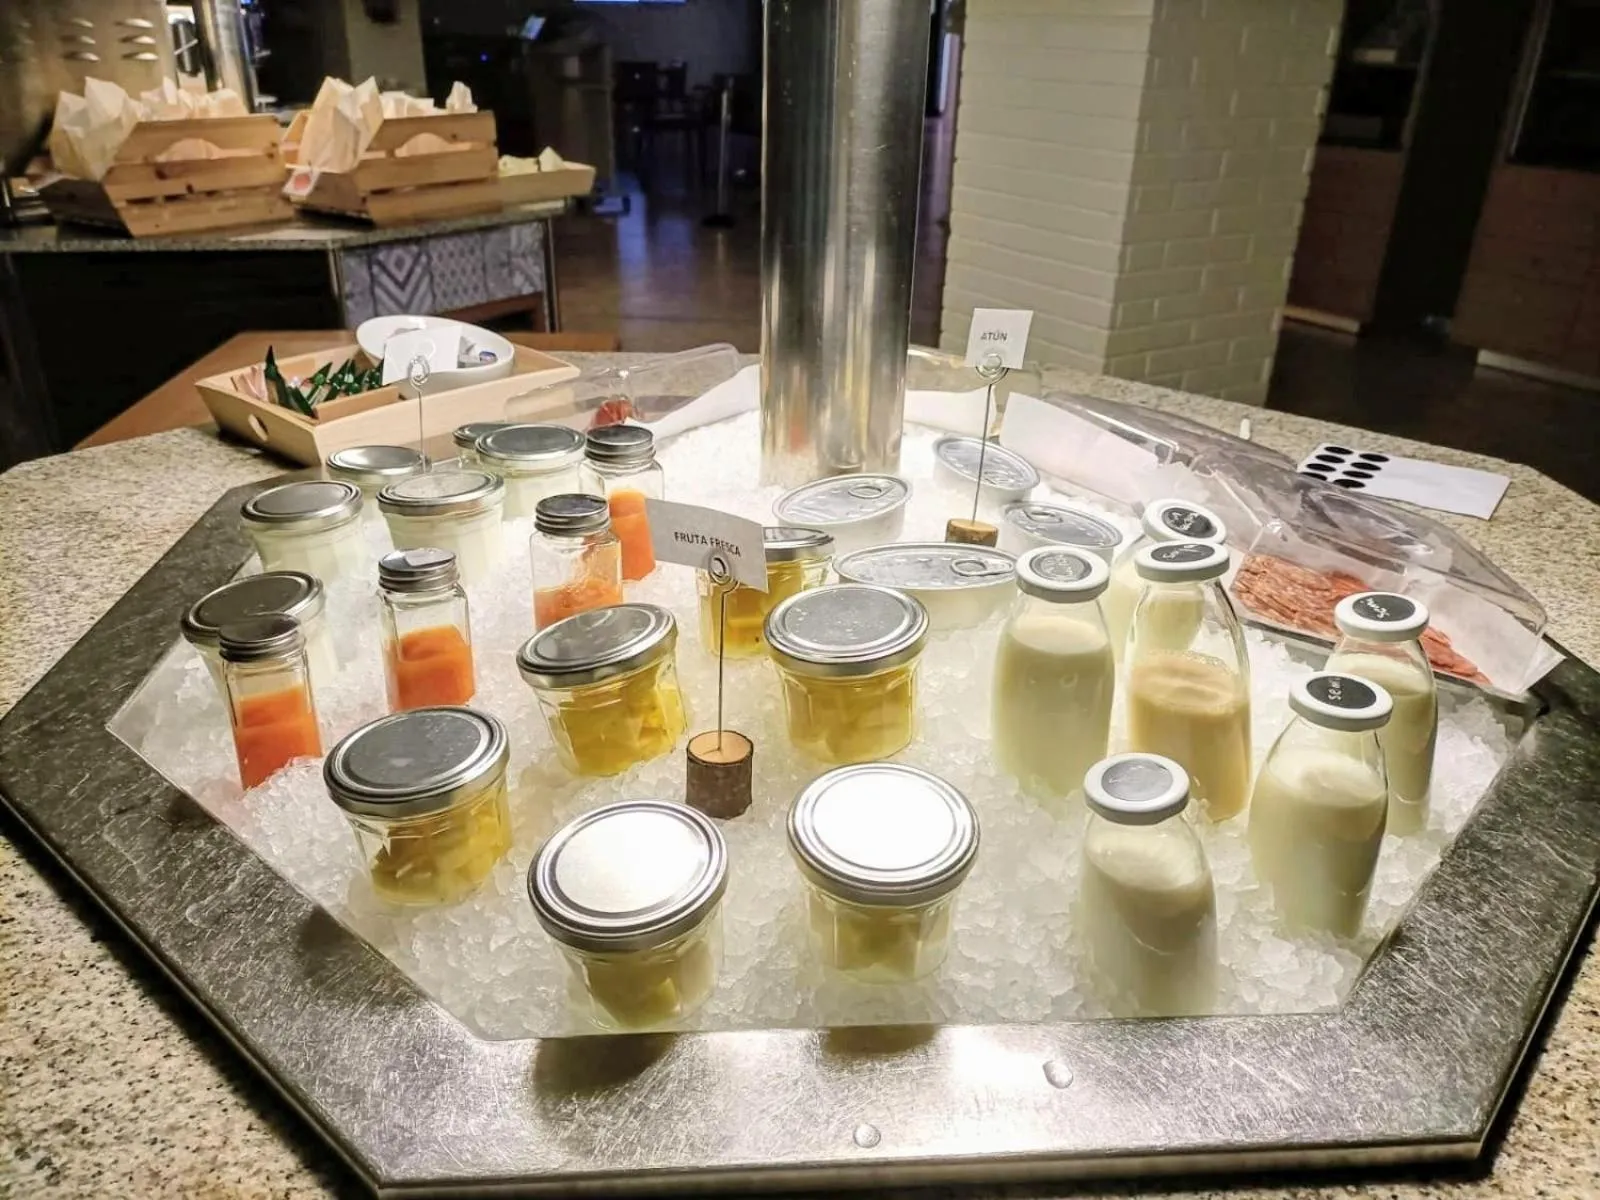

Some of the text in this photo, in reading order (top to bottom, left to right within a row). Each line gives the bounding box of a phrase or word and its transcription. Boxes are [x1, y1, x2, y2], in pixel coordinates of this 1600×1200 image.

[980, 329, 1008, 342] ATÚN
[674, 531, 741, 557] FRUTA FRESCA
